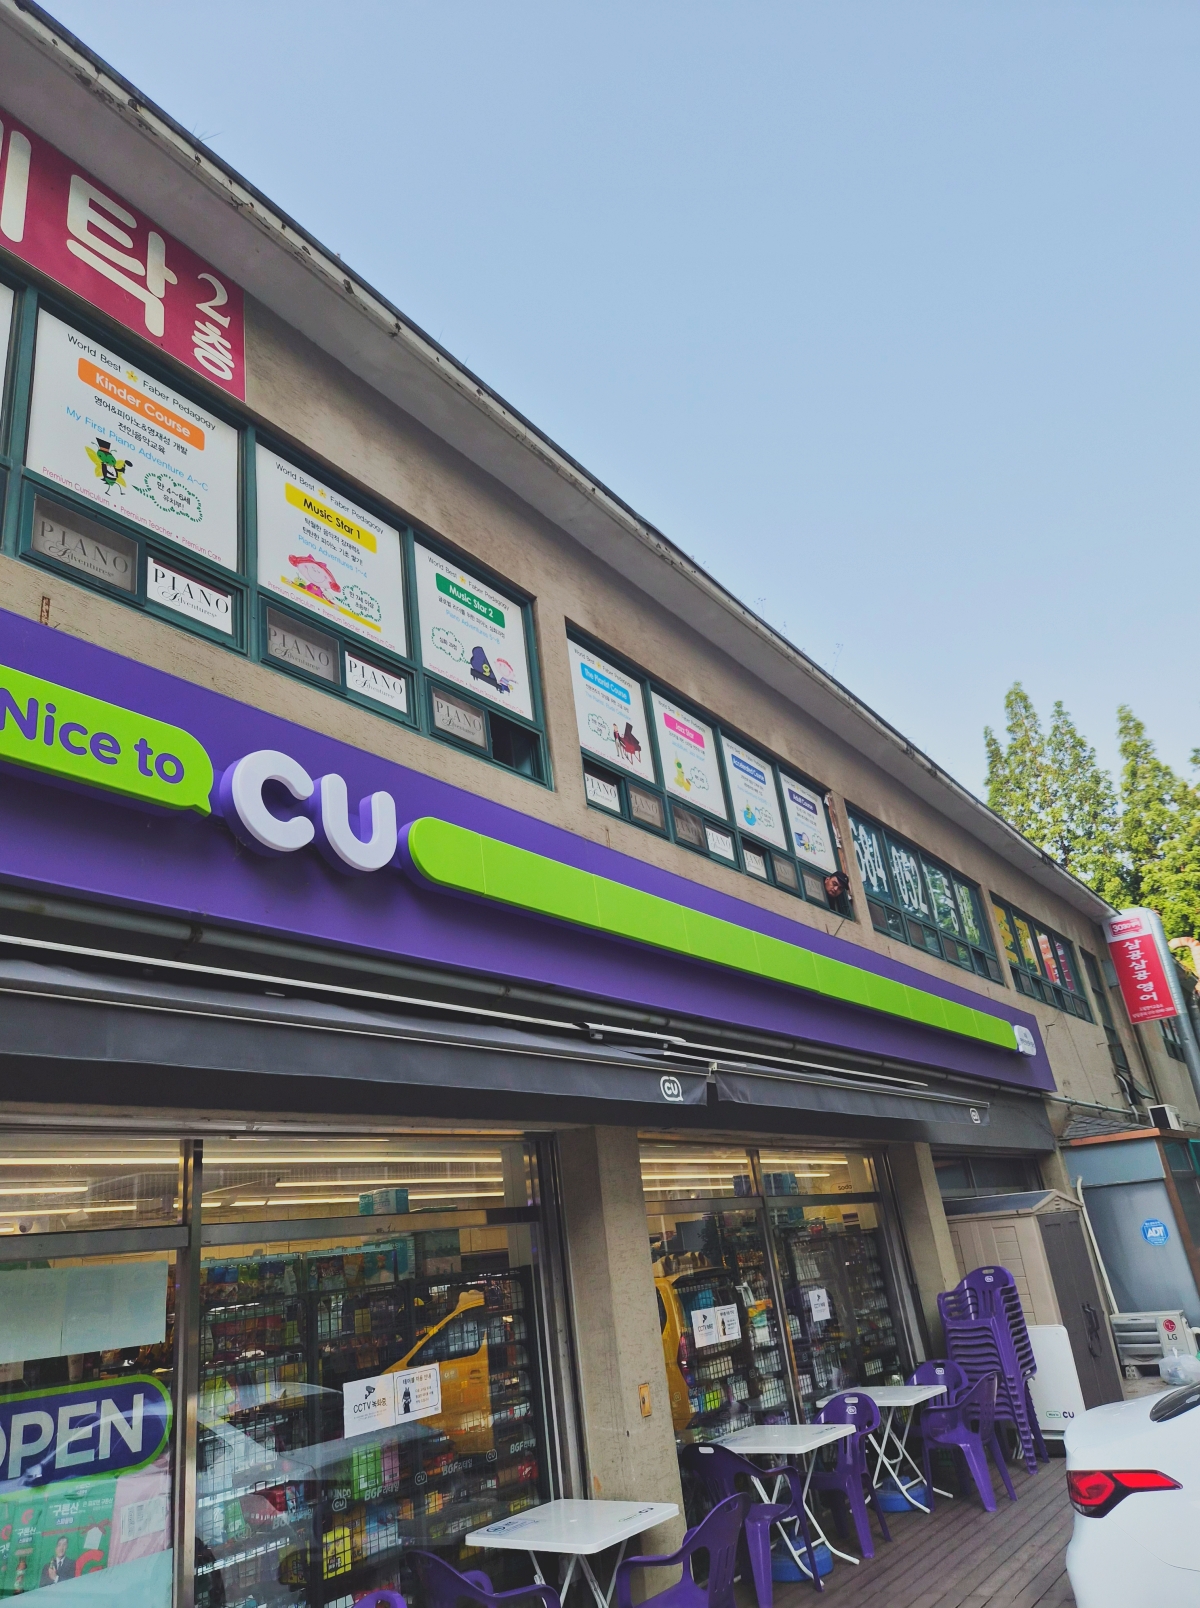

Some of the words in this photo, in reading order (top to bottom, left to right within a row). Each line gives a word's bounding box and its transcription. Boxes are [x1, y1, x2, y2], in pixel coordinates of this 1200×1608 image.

[192, 272, 233, 381] 2층
[67, 333, 96, 357] World
[100, 353, 121, 372] Best
[142, 379, 169, 402] Faber
[172, 398, 215, 432] Pedagogy
[95, 372, 140, 408] Kinder
[144, 401, 190, 438] Course
[66, 406, 81, 422] My
[85, 416, 105, 435] First
[109, 430, 135, 451] Piano
[138, 446, 183, 478] Adventure
[118, 421, 165, 455] 전인음악교육
[173, 440, 187, 455] 개발
[42, 466, 72, 487] Premium
[74, 481, 109, 506] Curriculum
[120, 505, 146, 524] Premium
[148, 519, 172, 537] Teacher
[181, 536, 206, 554] Premium
[207, 549, 221, 562] Care
[276, 462, 296, 481] World
[299, 476, 314, 492] Best
[330, 495, 348, 513] Faber
[351, 508, 383, 535] Pedagogy
[303, 497, 332, 523] Music
[335, 516, 353, 535] Star
[356, 529, 360, 540] 1
[41, 520, 130, 575] PIANO
[43, 538, 115, 578] Adventures
[298, 534, 316, 550] Piano
[318, 545, 352, 571] Adventures
[154, 571, 229, 615] PIANO
[158, 585, 217, 618] Adventures
[449, 584, 471, 605] Music
[473, 598, 487, 614] Star
[488, 607, 493, 618] 2
[267, 581, 288, 597] Premium
[290, 592, 315, 610] Curriculum
[322, 608, 341, 623] Premium
[342, 618, 360, 632] Teacher
[366, 631, 383, 644] Premium
[385, 640, 395, 650] Care
[269, 627, 330, 667] PIANO
[349, 655, 403, 695] PIANO
[437, 700, 482, 732] PIANO
[0, 687, 122, 765] Nice
[133, 737, 185, 784] to
[230, 749, 398, 871] CU
[1136, 981, 1158, 1001] 영어
[1148, 1227, 1163, 1237] ADT
[354, 1401, 371, 1413] CCTV
[1062, 1411, 1074, 1419] CU
[0, 1393, 145, 1479] PEN
[364, 1480, 400, 1501] BGF리테일
